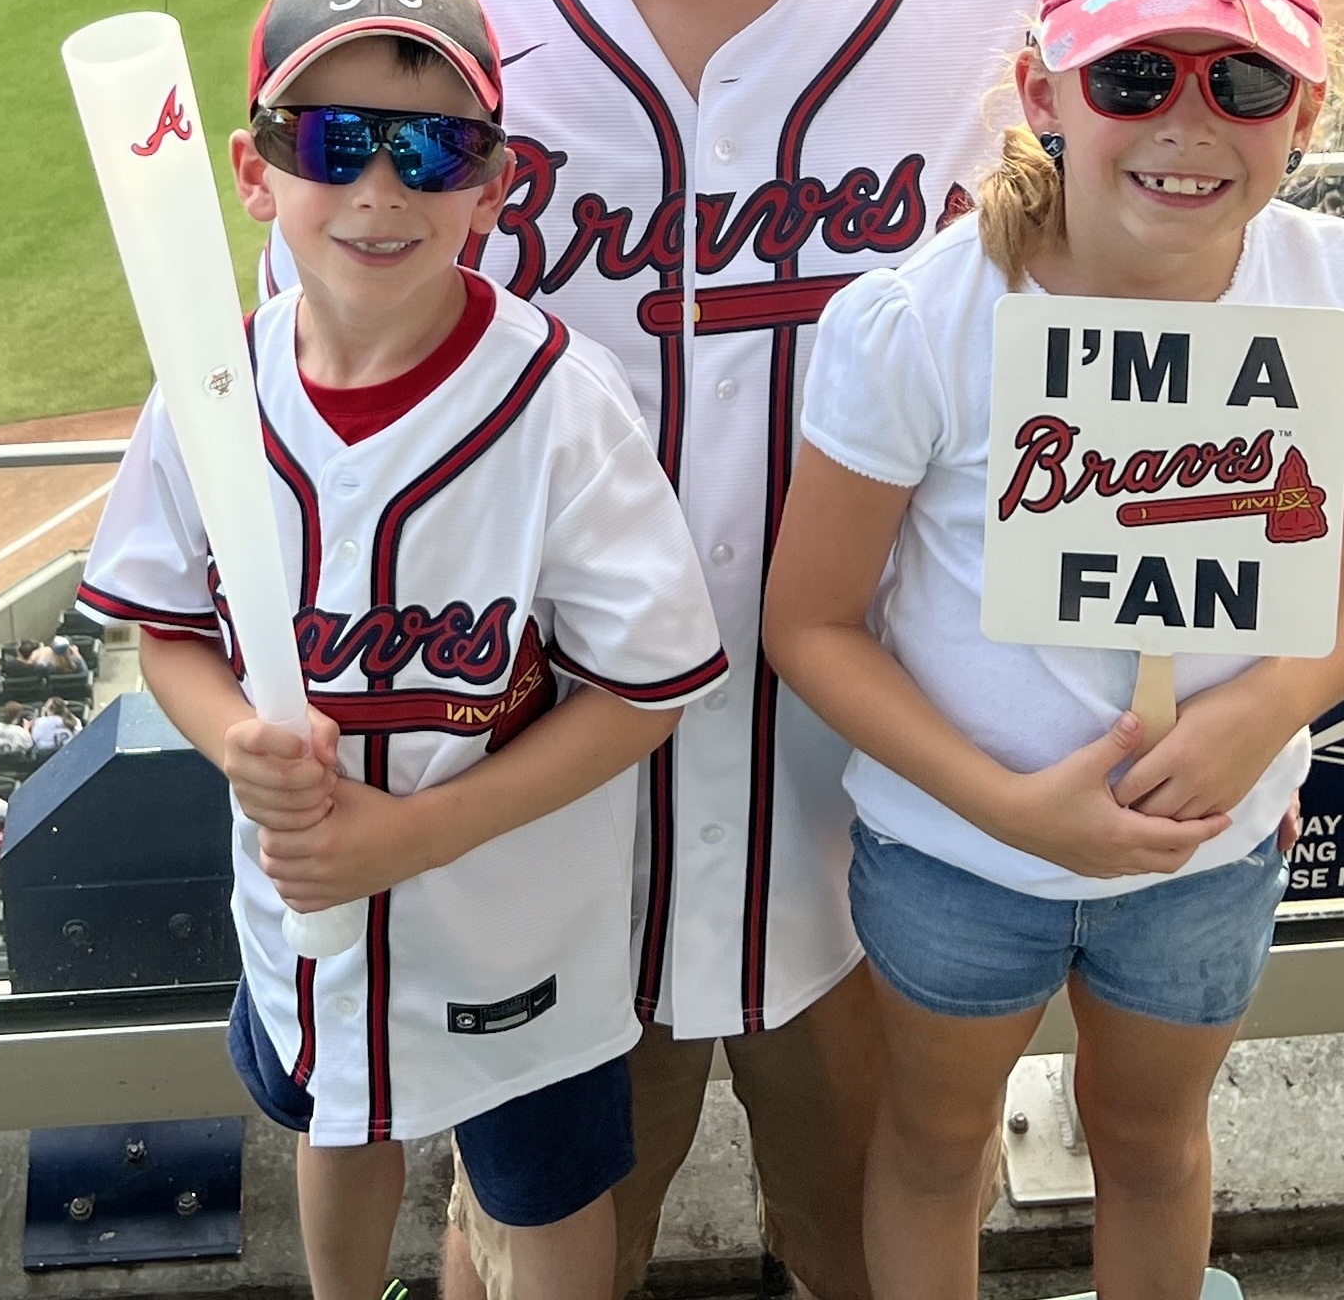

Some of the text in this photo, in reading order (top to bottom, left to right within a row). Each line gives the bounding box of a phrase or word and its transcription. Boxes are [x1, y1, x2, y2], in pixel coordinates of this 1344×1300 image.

[131, 84, 192, 156] A
[457, 135, 925, 300] Braves
[1226, 336, 1299, 409] A
[998, 415, 1275, 521] Braves
[1058, 552, 1261, 631] FAN
